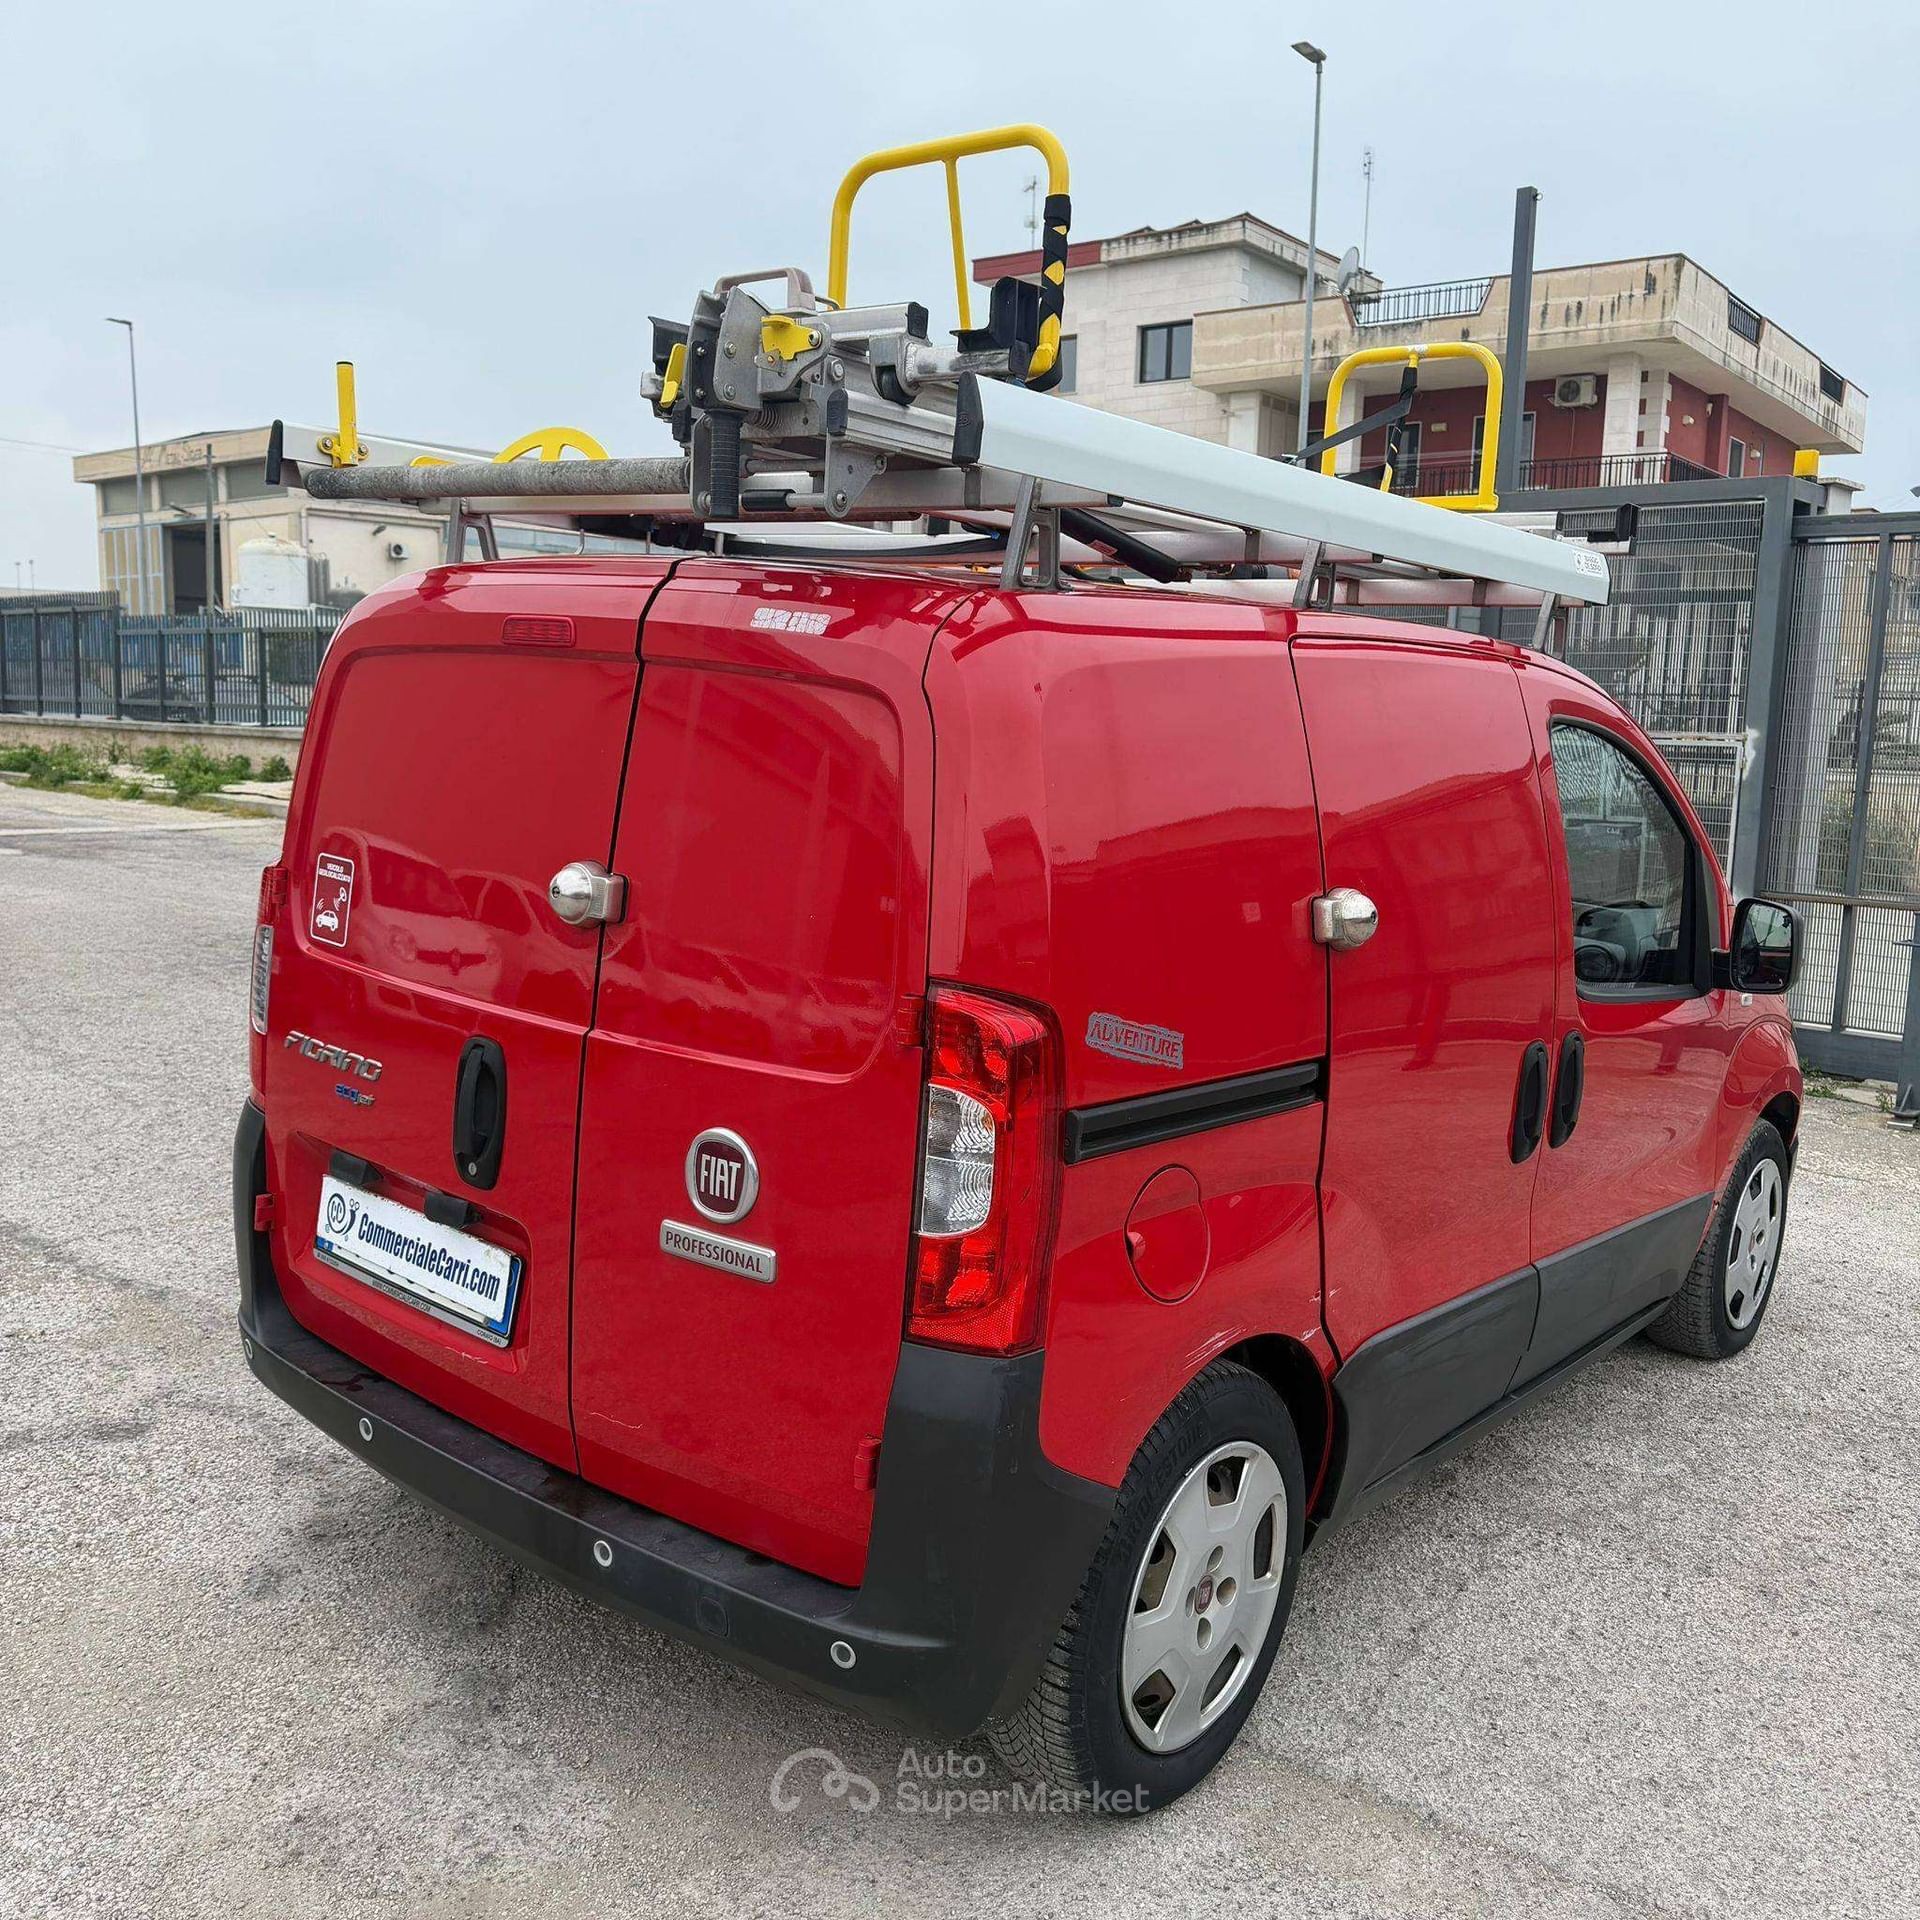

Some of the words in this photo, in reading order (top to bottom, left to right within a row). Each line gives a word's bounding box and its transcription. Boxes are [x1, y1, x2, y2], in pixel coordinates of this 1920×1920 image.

[284, 1030, 383, 1081] FIORINO
[1090, 1020, 1181, 1058] ADVENTURE
[700, 1153, 742, 1201] FIAT
[358, 1213, 501, 1302] CommercialeCarri.com
[665, 1231, 763, 1274] PROFESSIONAL
